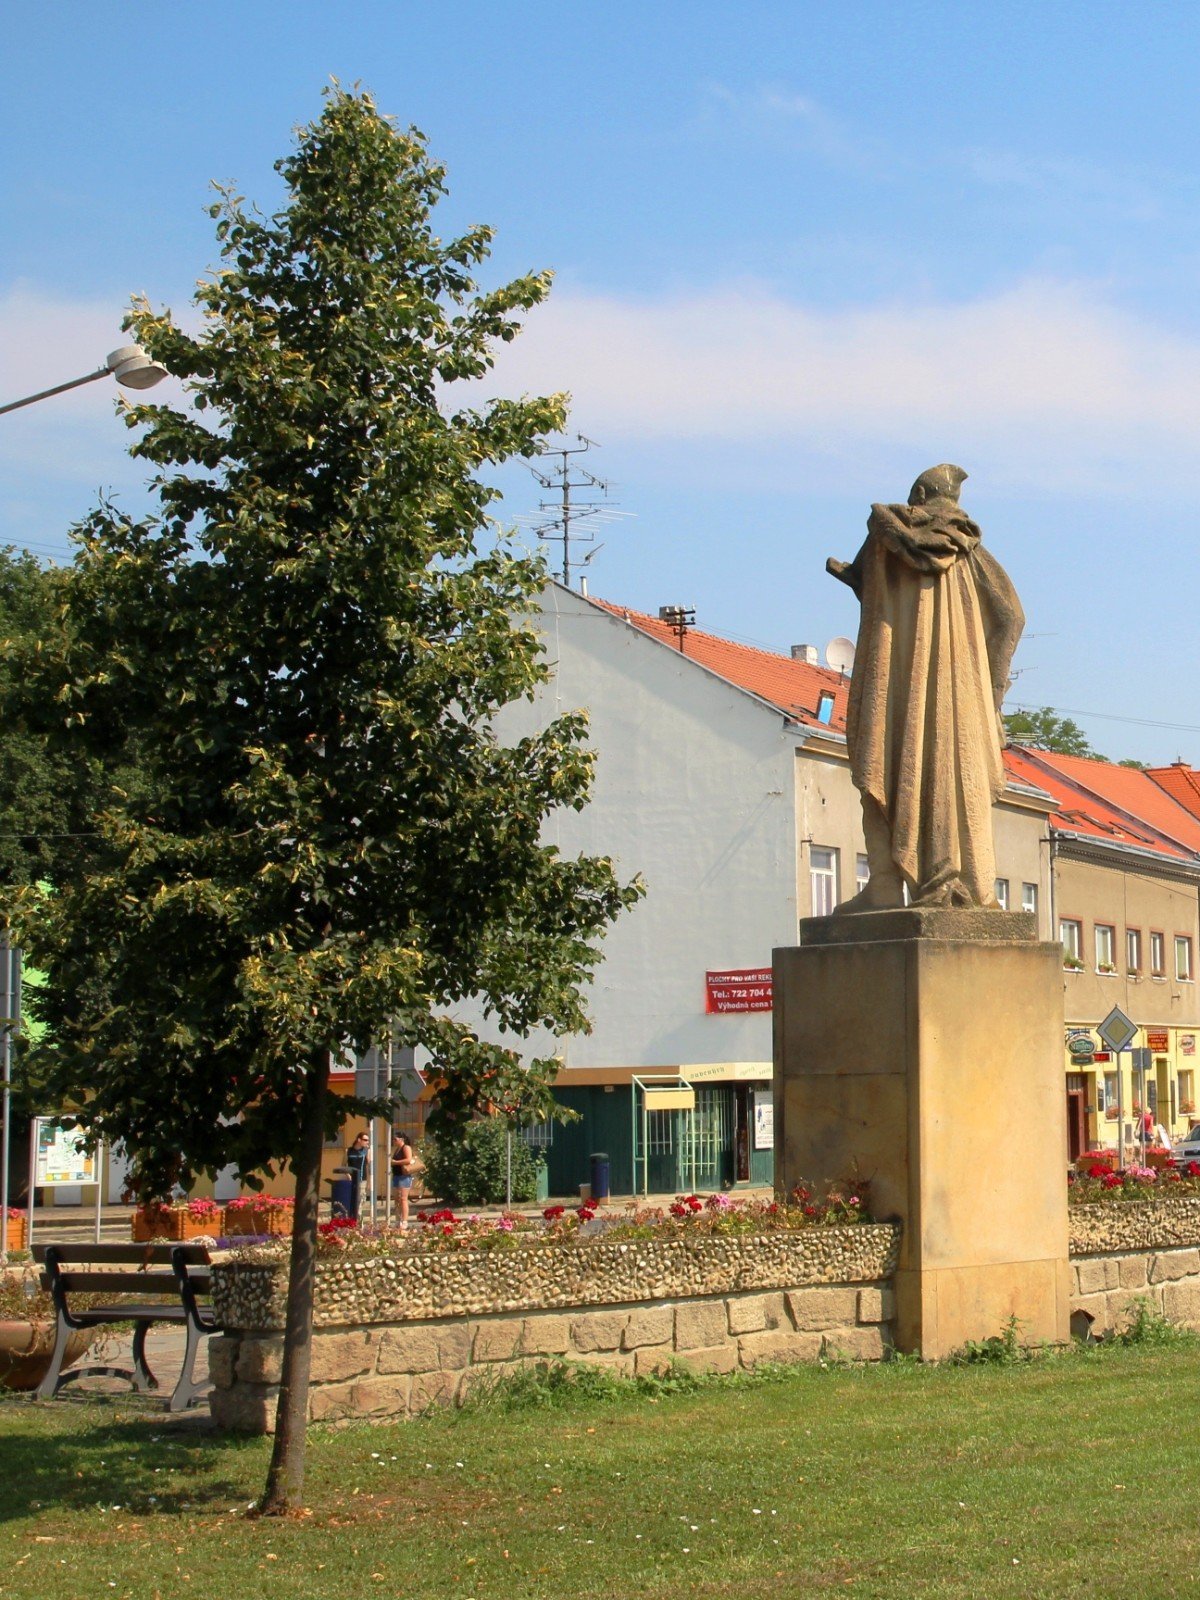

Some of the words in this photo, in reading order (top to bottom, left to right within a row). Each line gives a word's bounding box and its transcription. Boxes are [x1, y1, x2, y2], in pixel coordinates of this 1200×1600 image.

[708, 975, 730, 983] PLOCHY
[712, 990, 730, 999] Tel.:
[731, 989, 748, 998] 722
[749, 988, 765, 997] 704
[718, 1002, 749, 1011] Výhodná
